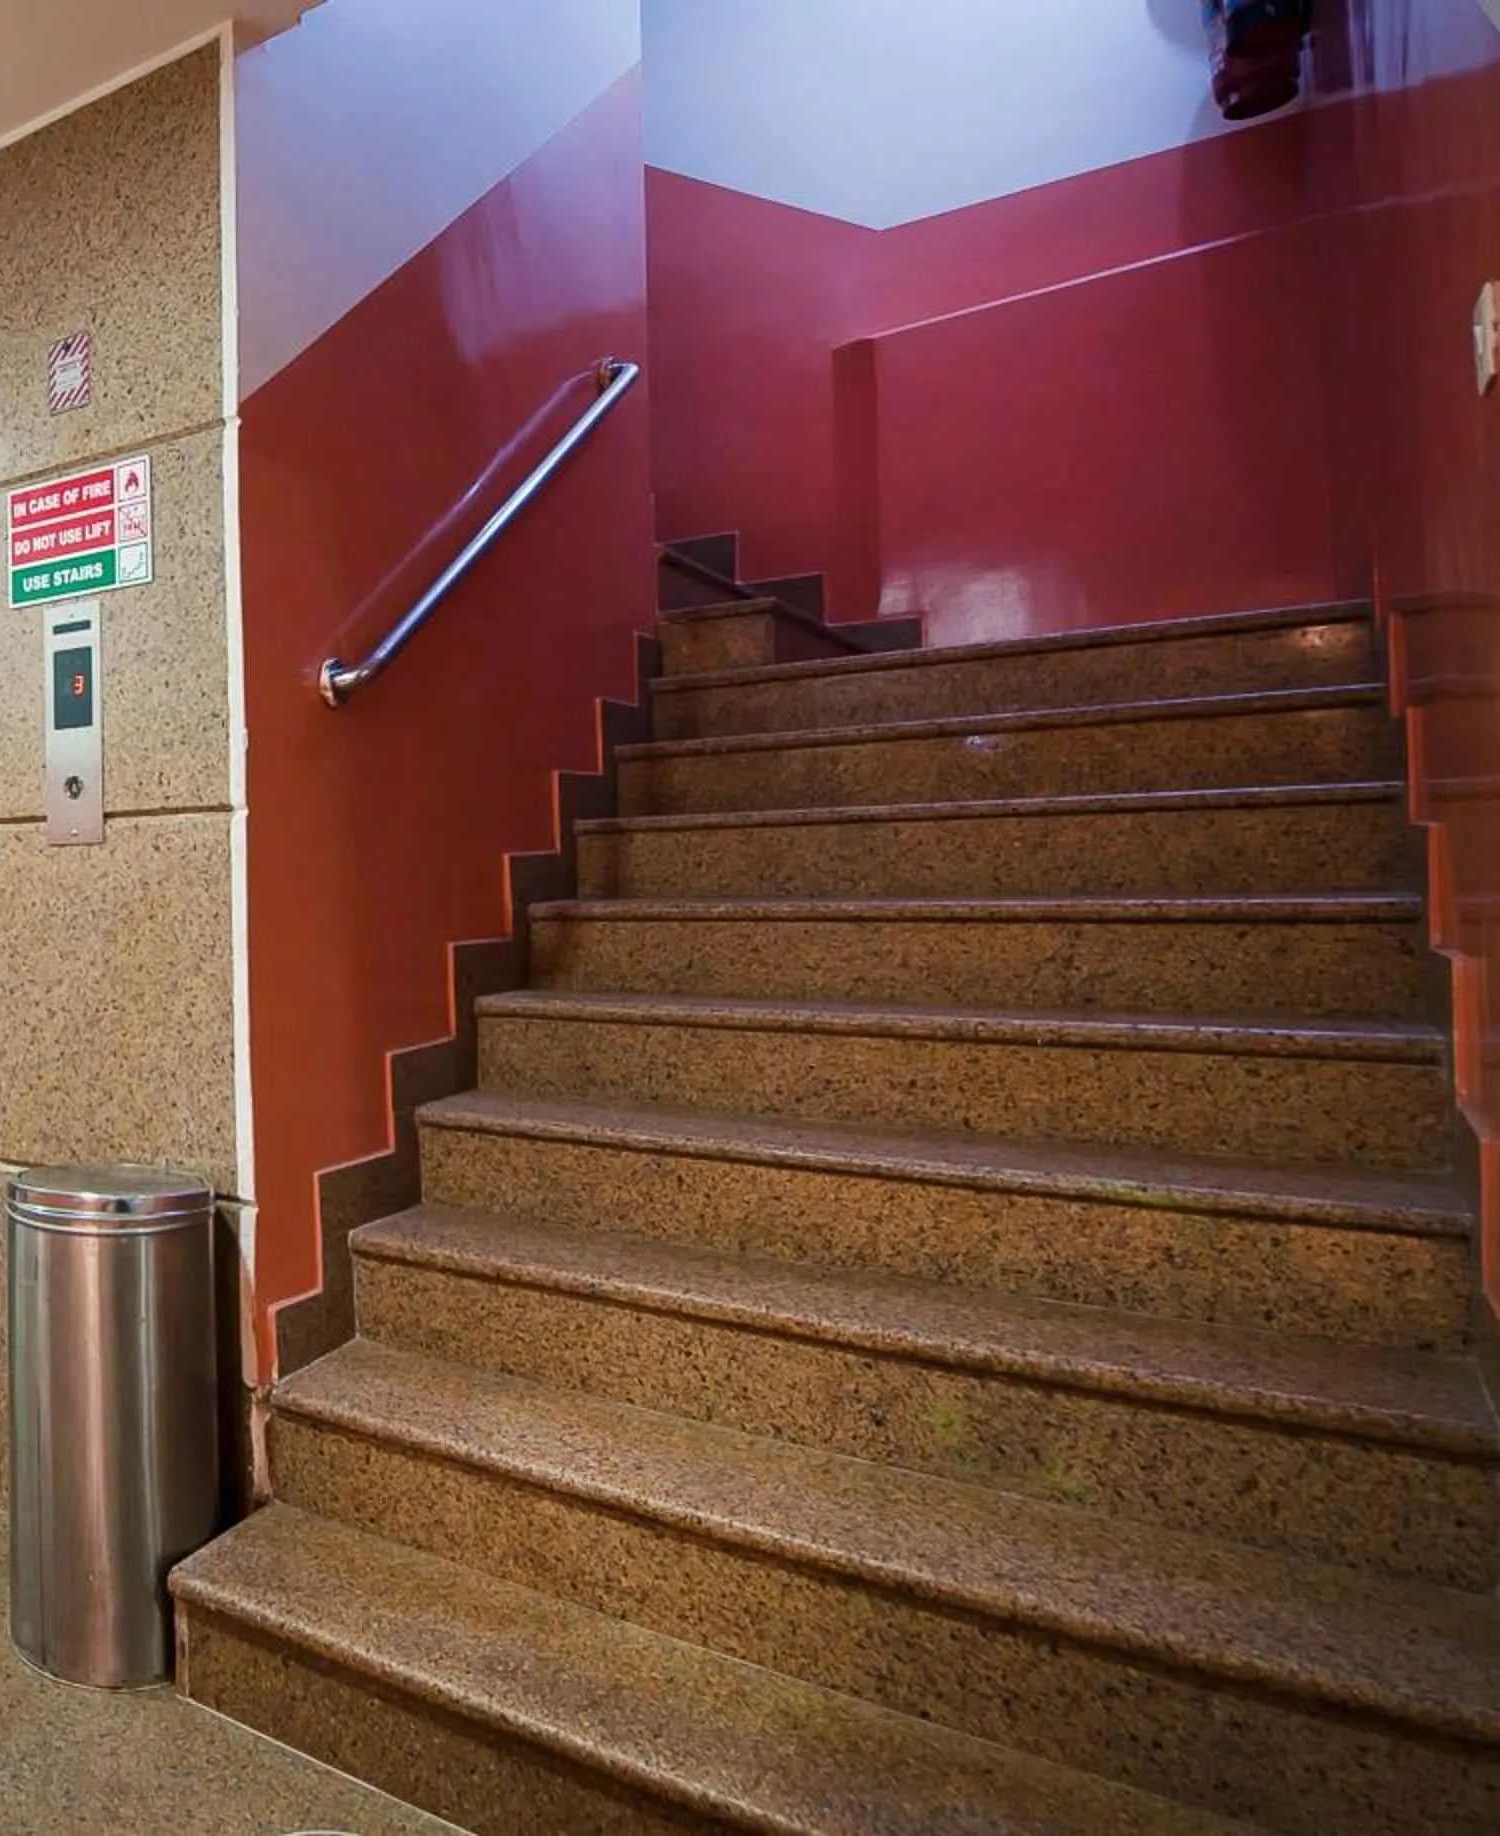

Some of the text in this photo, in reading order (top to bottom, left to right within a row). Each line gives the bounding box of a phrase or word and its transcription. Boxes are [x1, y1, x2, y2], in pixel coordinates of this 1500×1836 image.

[13, 479, 112, 518] IN CASE OF FIRE
[14, 520, 112, 556] DO NOT USE LIFT
[22, 563, 103, 592] USE STAIRS
[73, 675, 85, 695] 3
